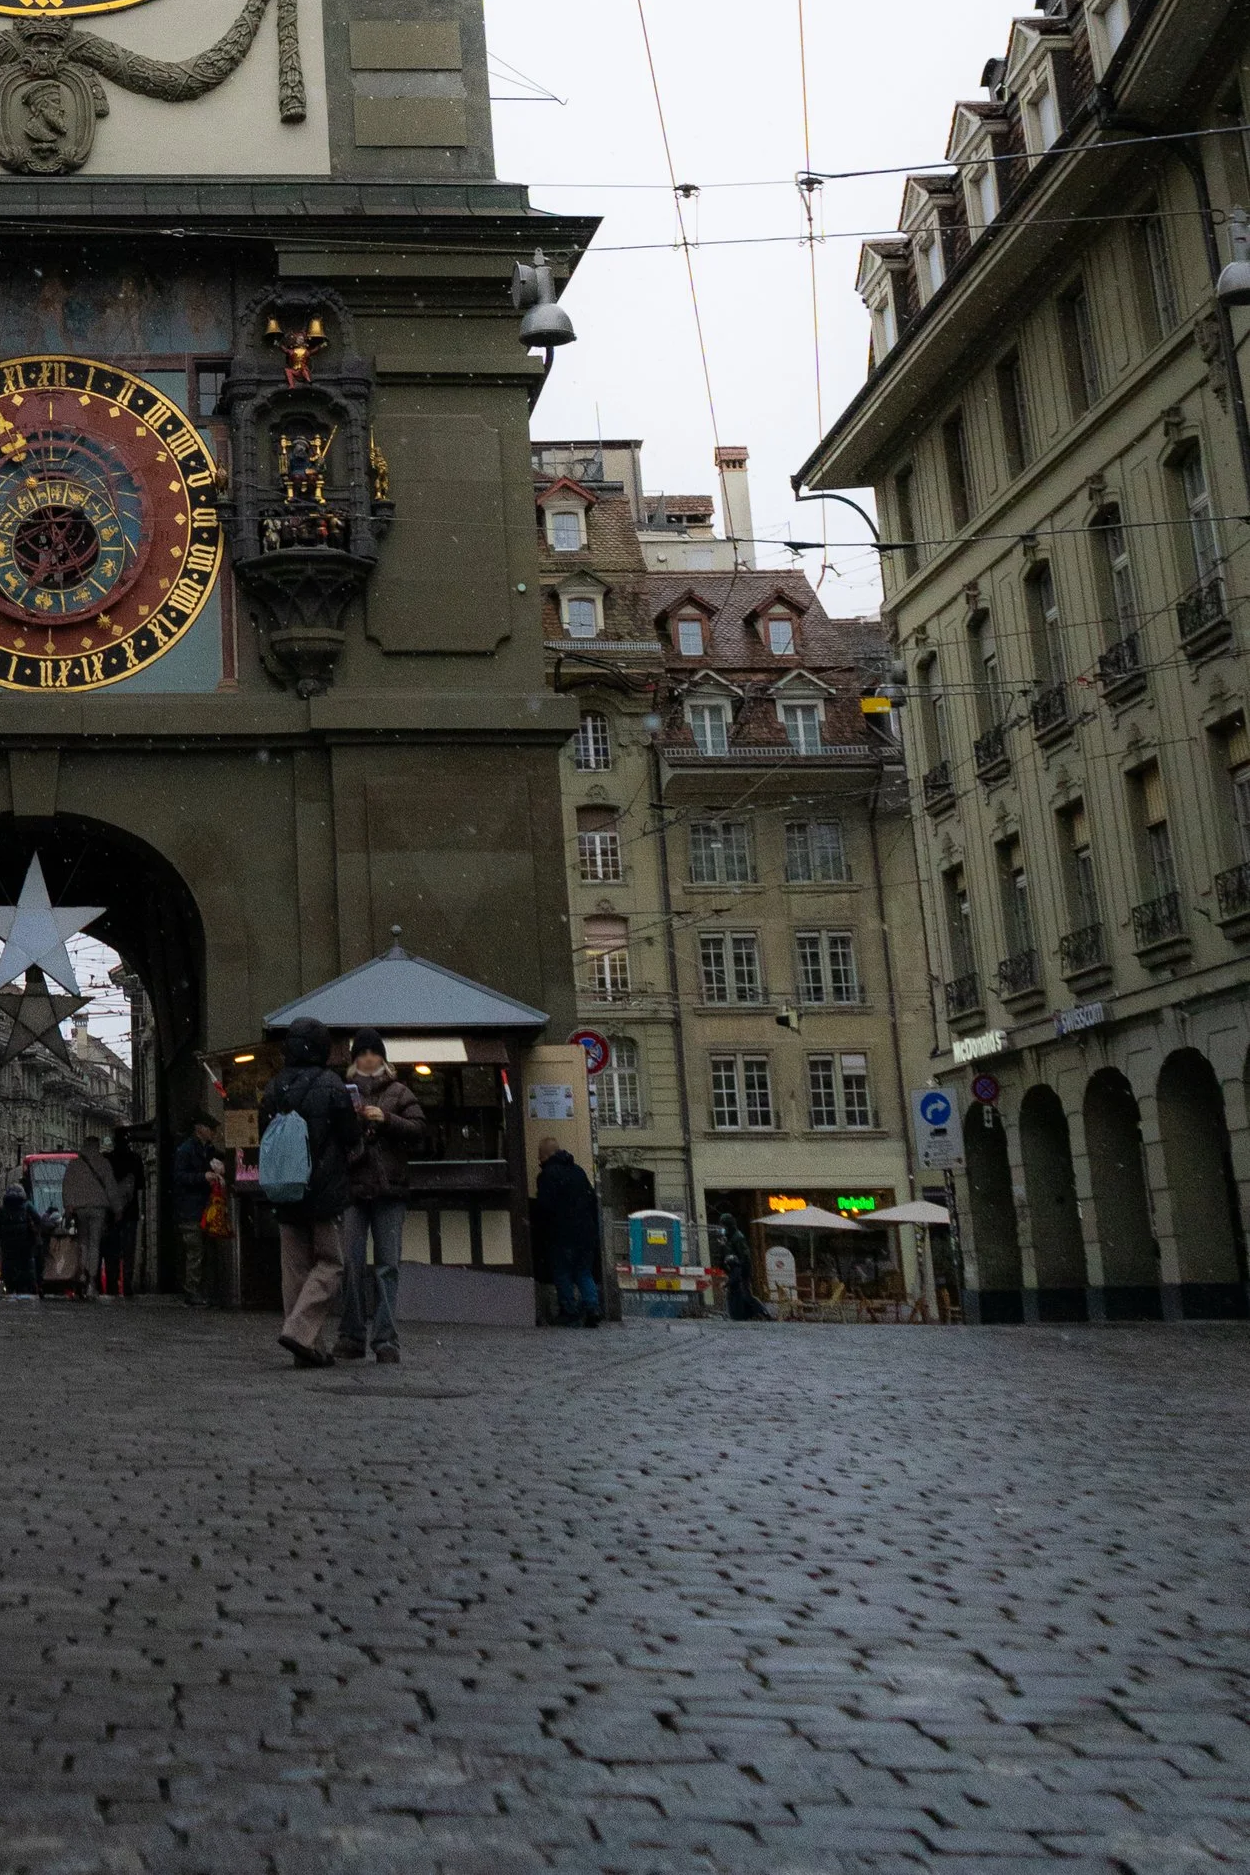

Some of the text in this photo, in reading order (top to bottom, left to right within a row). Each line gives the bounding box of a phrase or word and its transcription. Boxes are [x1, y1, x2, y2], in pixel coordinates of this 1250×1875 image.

[3, 365, 26, 392] XI
[38, 362, 67, 386] XII
[88, 368, 95, 390] I
[116, 380, 137, 405] II
[143, 400, 171, 429] III
[167, 428, 198, 460] IIII
[121, 639, 139, 668] X
[8, 656, 18, 680] I
[1060, 1001, 1106, 1035] swisscom
[952, 1030, 1005, 1064] McDonald's
